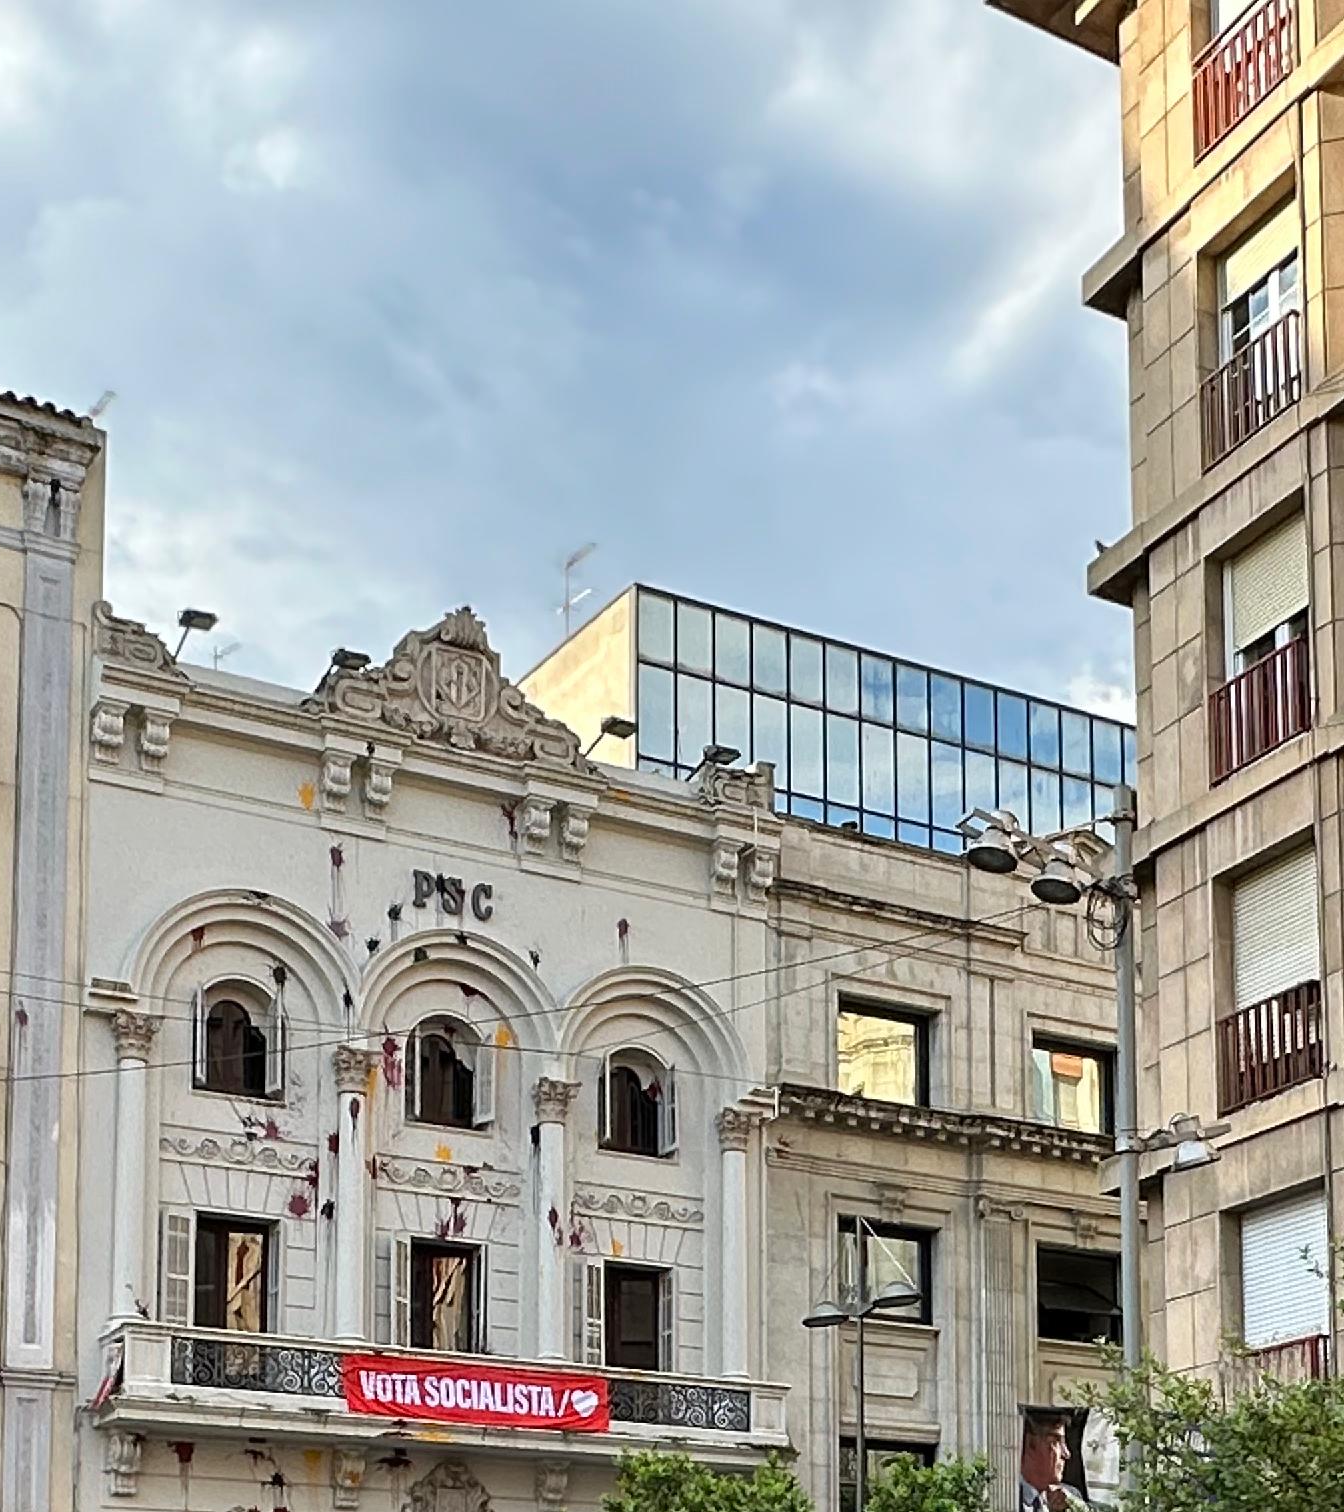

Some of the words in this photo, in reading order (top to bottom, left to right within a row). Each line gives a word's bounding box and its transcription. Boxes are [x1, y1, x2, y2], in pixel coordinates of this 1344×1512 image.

[413, 869, 493, 921] PSC
[359, 1371, 421, 1405] VOTA
[423, 1376, 556, 1417] SOCIALISTA
